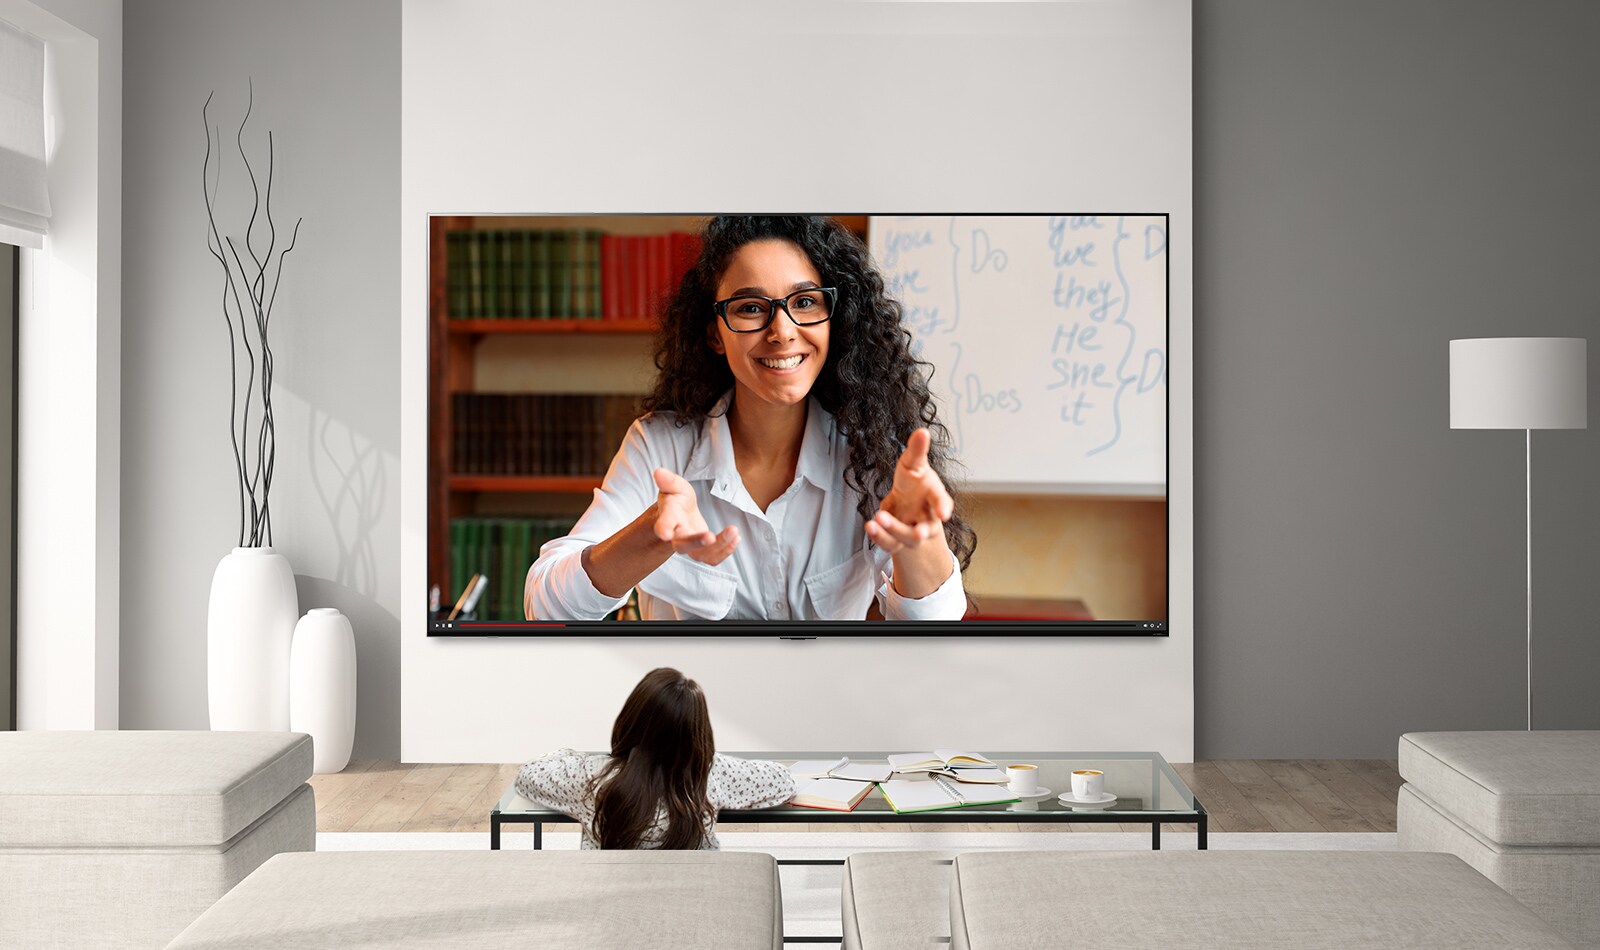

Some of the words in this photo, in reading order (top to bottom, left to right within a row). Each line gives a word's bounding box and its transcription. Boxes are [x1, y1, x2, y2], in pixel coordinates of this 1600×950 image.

[883, 228, 934, 268] you
[972, 228, 1009, 273] Do
[1053, 241, 1097, 268] we
[1053, 272, 1121, 322] they
[1051, 322, 1104, 354] He
[965, 373, 1023, 414] Does
[1060, 391, 1095, 426] it
